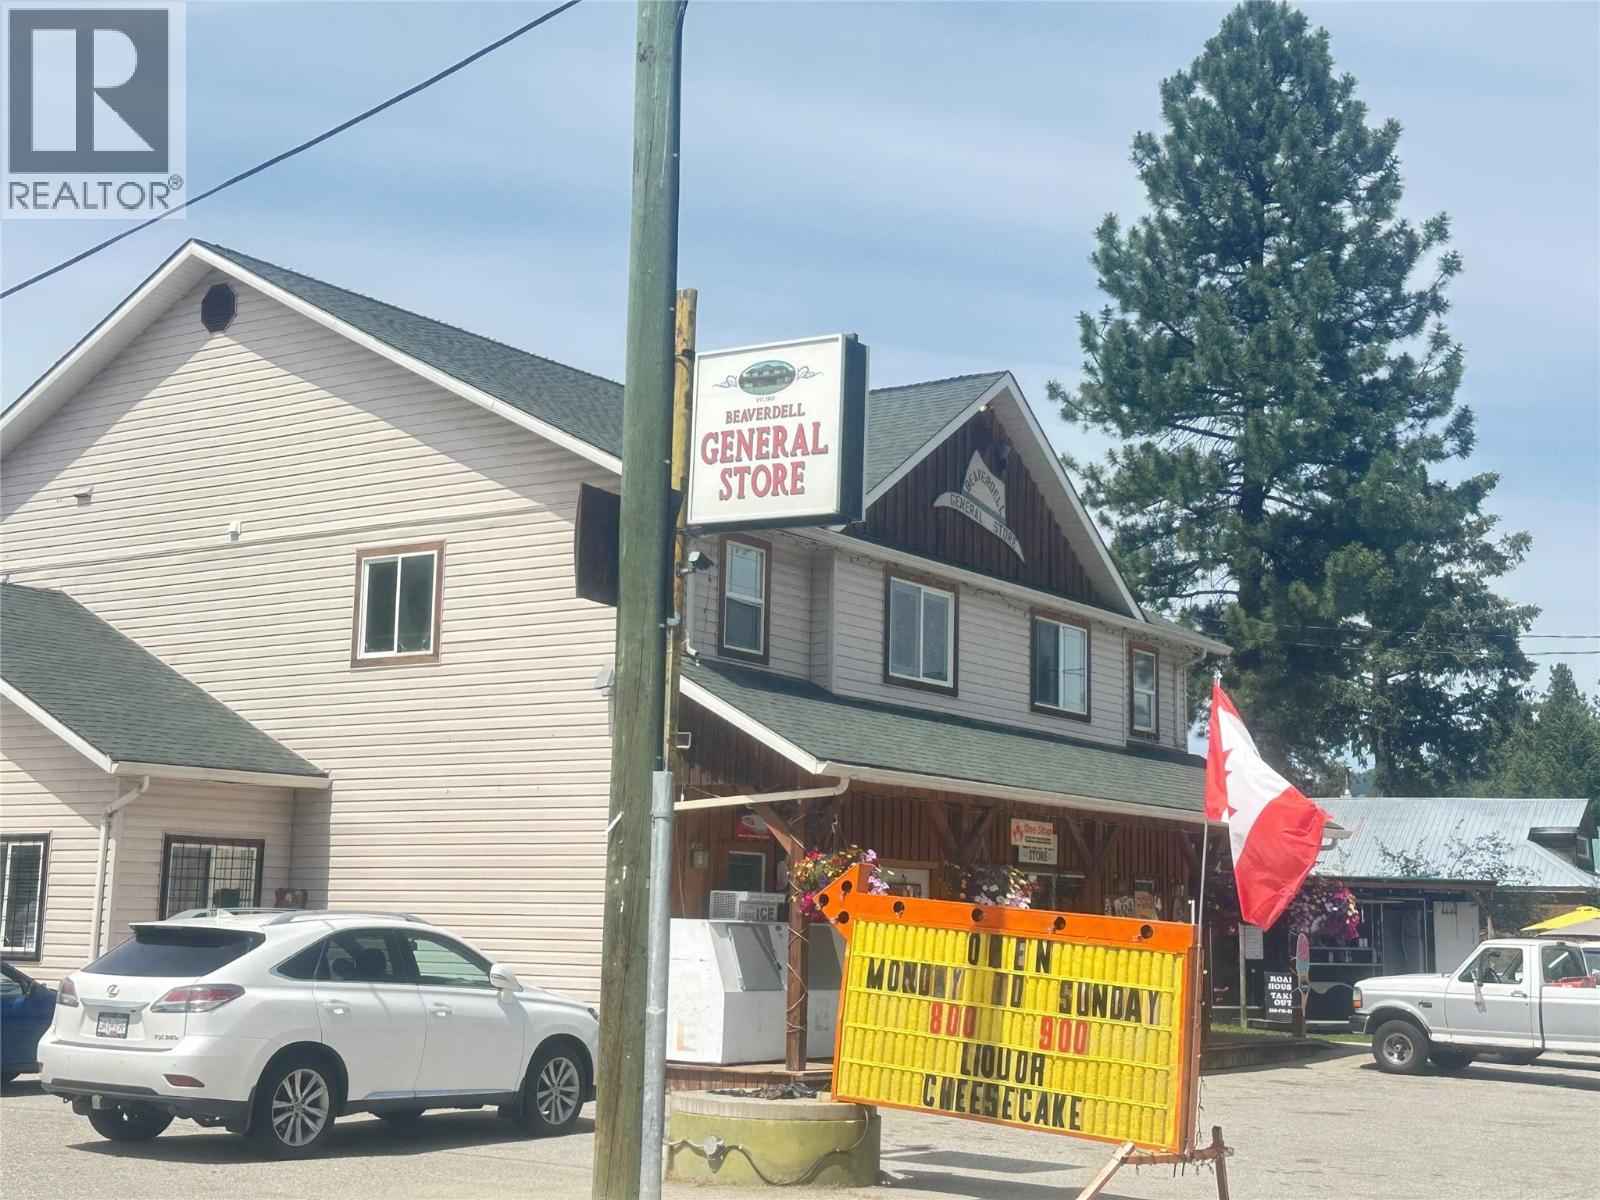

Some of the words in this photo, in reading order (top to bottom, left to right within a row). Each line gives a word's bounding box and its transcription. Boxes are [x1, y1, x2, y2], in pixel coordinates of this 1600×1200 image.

[725, 402, 806, 424] BEAVERDELL
[700, 421, 829, 465] GENERAL
[719, 461, 806, 501] STORE
[964, 469, 1005, 512] BEAVERDELL
[950, 494, 983, 523] GENERAL
[993, 521, 1016, 548] STORE
[1028, 849, 1048, 862] STORE
[756, 907, 775, 921] ICE
[1058, 980, 1158, 1025] SUNDAY
[930, 1001, 976, 1038] 800
[1039, 1015, 1089, 1055] 900
[961, 1043, 1045, 1087] LIQUOR
[922, 1074, 1082, 1131] CHEESECAKE
